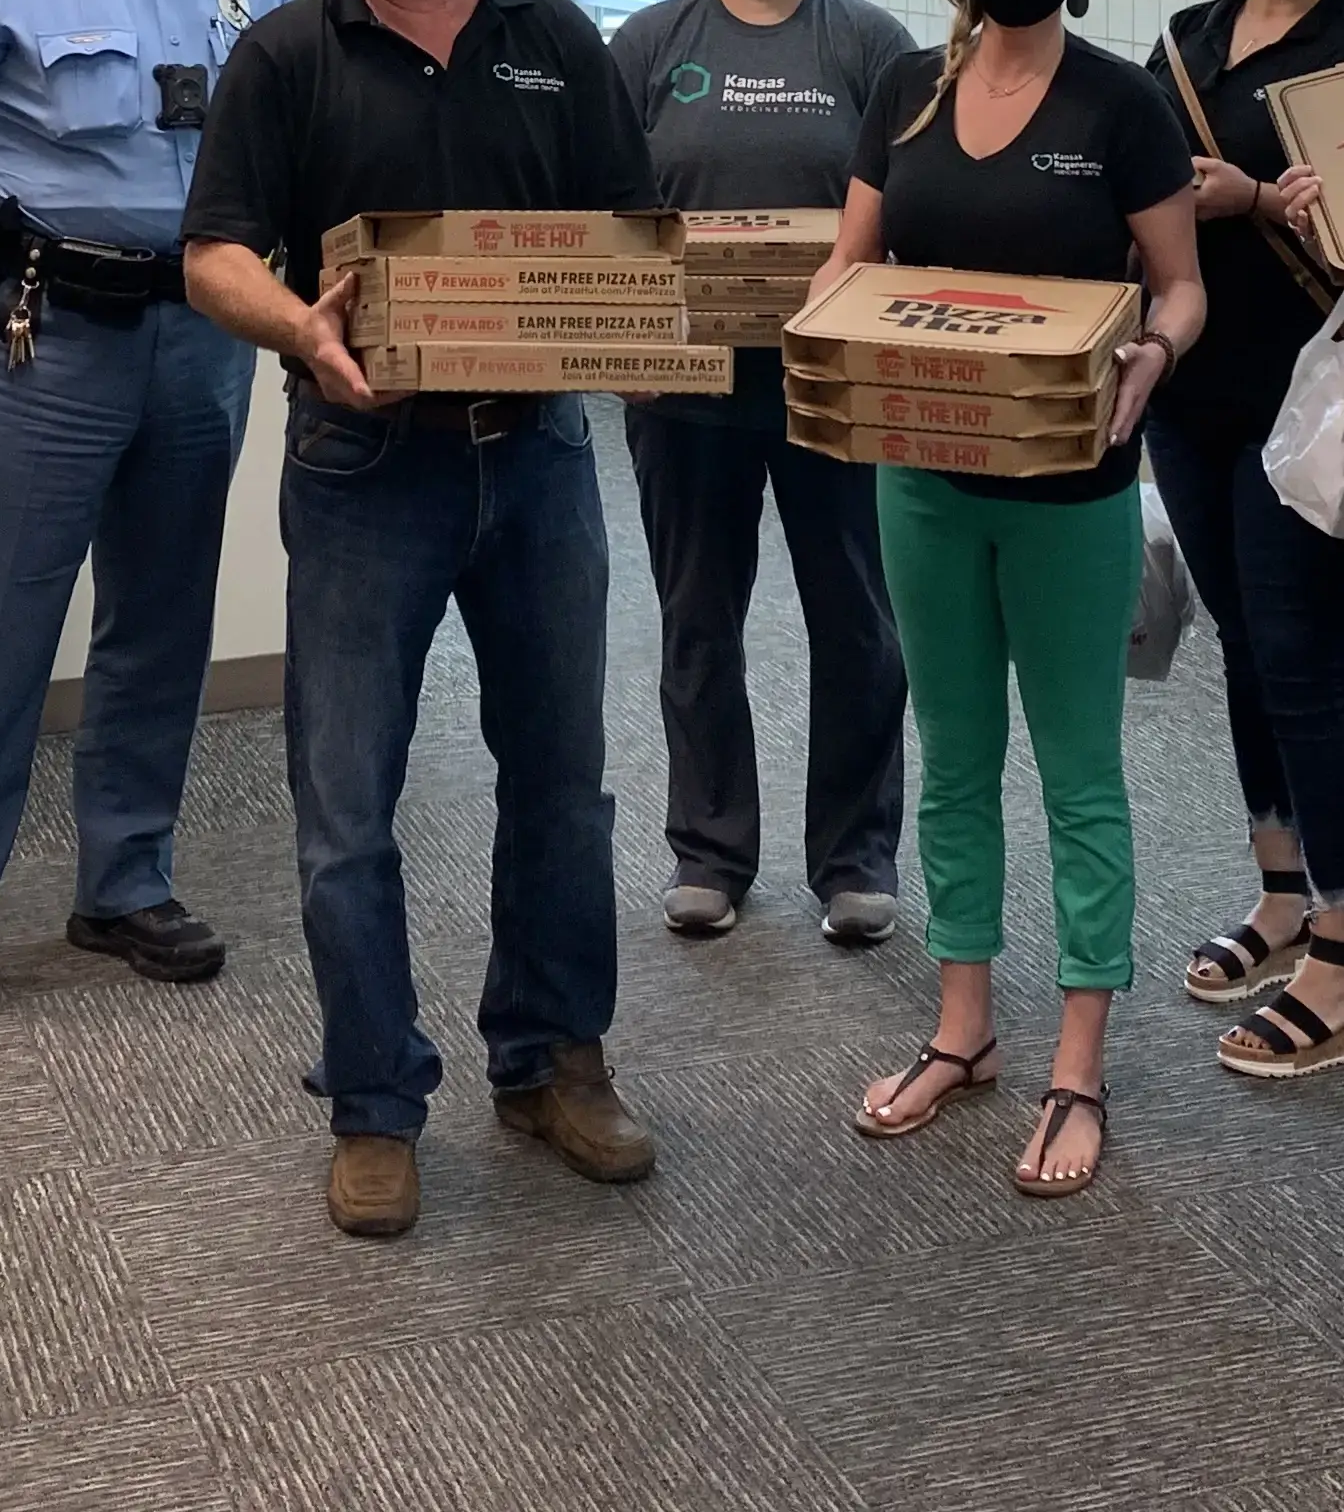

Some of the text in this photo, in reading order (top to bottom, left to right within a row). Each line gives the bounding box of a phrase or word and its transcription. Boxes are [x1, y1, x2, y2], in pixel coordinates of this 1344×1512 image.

[724, 74, 785, 89] Kansas
[722, 88, 836, 107] Regenerative
[721, 105, 779, 113] MEDICINE
[511, 231, 590, 248] THE HUT
[394, 276, 420, 287] HUT
[441, 277, 505, 288] REWARDS
[518, 272, 676, 286] EARN FREE PIZZA FAST
[518, 286, 538, 294] Join
[542, 286, 552, 294] at
[885, 300, 1047, 325] Pizza
[394, 319, 419, 330] HUT
[440, 320, 504, 331] REWARDS
[517, 316, 674, 329] EARN FREE PIZZA FAST
[879, 314, 1009, 336] Hut
[518, 330, 538, 339] Join
[541, 331, 551, 339] at
[430, 361, 544, 374] HUT REWARDS
[561, 357, 725, 372] EARN FREE PIZZA FAST
[562, 371, 582, 380] Join
[585, 372, 596, 381] at
[911, 362, 944, 380] THE
[949, 365, 987, 383] HUT
[917, 407, 951, 424] THE
[955, 408, 993, 428] HUT
[917, 447, 951, 464] THE
[955, 448, 990, 468] HUT
